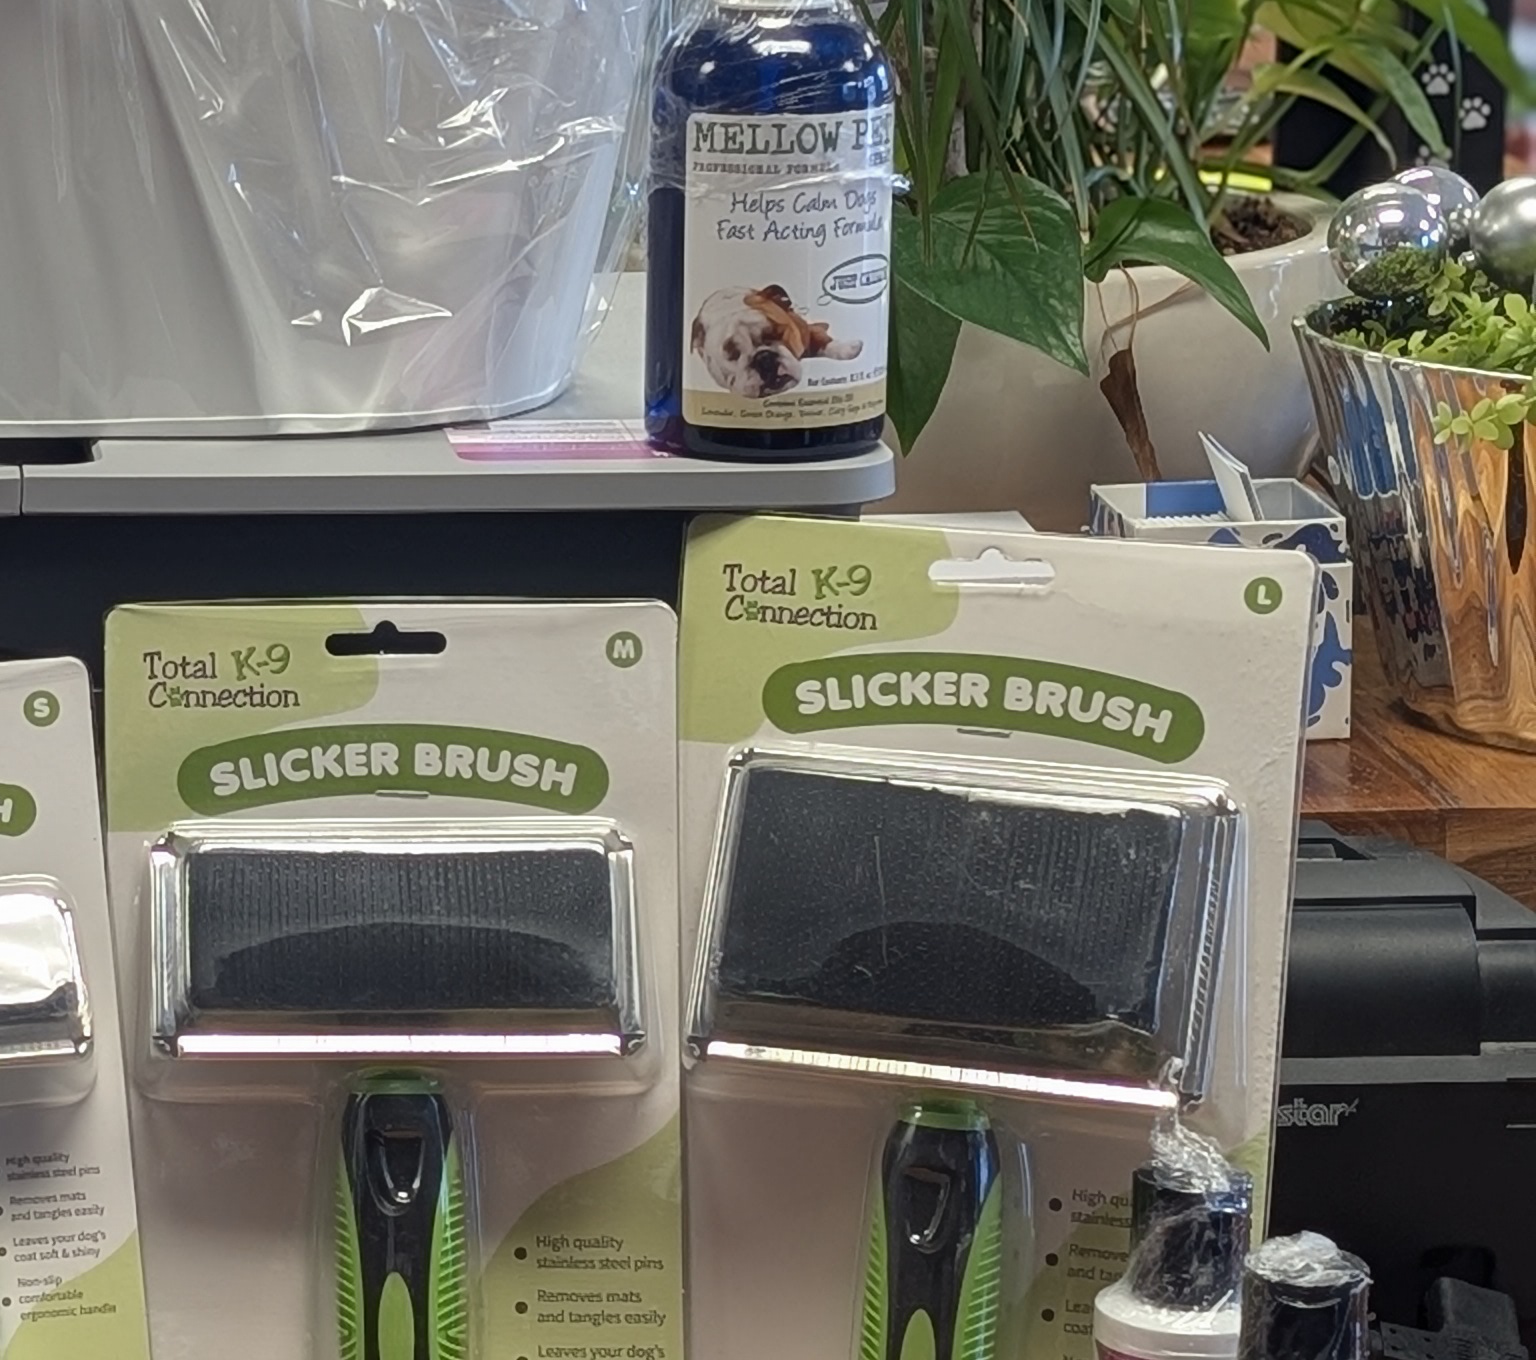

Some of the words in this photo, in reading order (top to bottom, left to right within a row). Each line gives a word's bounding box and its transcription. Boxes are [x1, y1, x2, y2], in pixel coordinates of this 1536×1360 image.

[693, 121, 843, 155] MELLOW
[730, 191, 785, 220] Helps
[793, 192, 838, 215] Calm
[844, 190, 877, 214] Dogs
[716, 219, 755, 241] Fast
[763, 220, 827, 247] Acting
[723, 564, 796, 596] Total
[812, 564, 872, 599] K-9
[613, 639, 635, 659] M
[144, 651, 217, 681] Total
[231, 644, 291, 681] K-9
[796, 671, 989, 715] SLICKER
[1004, 680, 1173, 744] BRUSH
[209, 743, 399, 796] SLICKER
[415, 743, 578, 796] BRUSH
[6, 1154, 30, 1167] High
[32, 1152, 70, 1166] quality
[1072, 1189, 1107, 1208] High
[11, 1211, 31, 1221] and
[33, 1207, 72, 1221] tangles
[74, 1204, 105, 1217] easily
[13, 1235, 49, 1247] Leaves
[51, 1235, 75, 1246] your
[536, 1235, 570, 1253] High
[573, 1236, 624, 1252] quality
[14, 1251, 37, 1262] coat
[39, 1249, 59, 1260] soft
[72, 1246, 101, 1258] shiny
[1069, 1244, 1129, 1262] Remove
[536, 1256, 596, 1269] stainless
[598, 1256, 631, 1269] steel
[634, 1256, 664, 1272] pins
[1067, 1267, 1096, 1280] and
[19, 1289, 83, 1304] comfortable
[537, 1290, 603, 1302] Removes
[606, 1292, 642, 1303] mats
[1065, 1299, 1093, 1314] Lea
[537, 1311, 564, 1323] and
[569, 1311, 621, 1327] tangles
[625, 1310, 666, 1327] easily
[538, 1345, 586, 1358] Leaves
[589, 1347, 623, 1360] your
